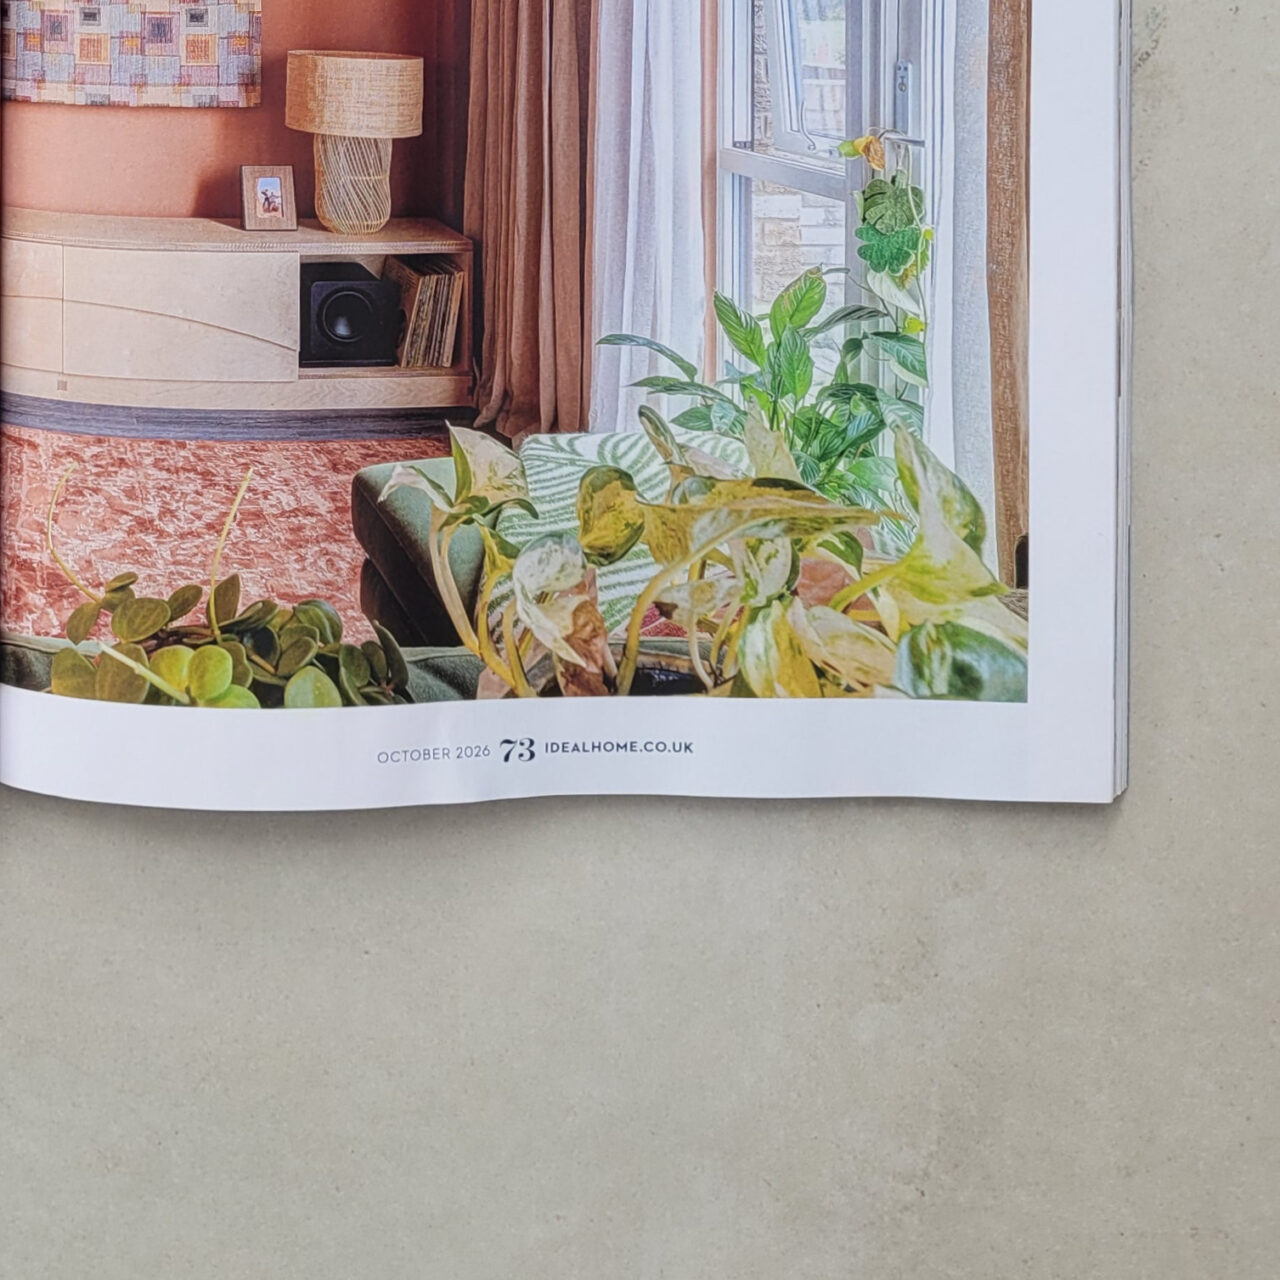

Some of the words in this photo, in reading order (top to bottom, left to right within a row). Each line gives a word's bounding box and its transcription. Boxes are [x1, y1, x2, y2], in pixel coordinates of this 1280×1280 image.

[377, 747, 451, 763] OCTOBER
[456, 745, 490, 759] 2026
[499, 737, 536, 763] 73
[545, 741, 693, 753] IDEALHOME.CO.UK
